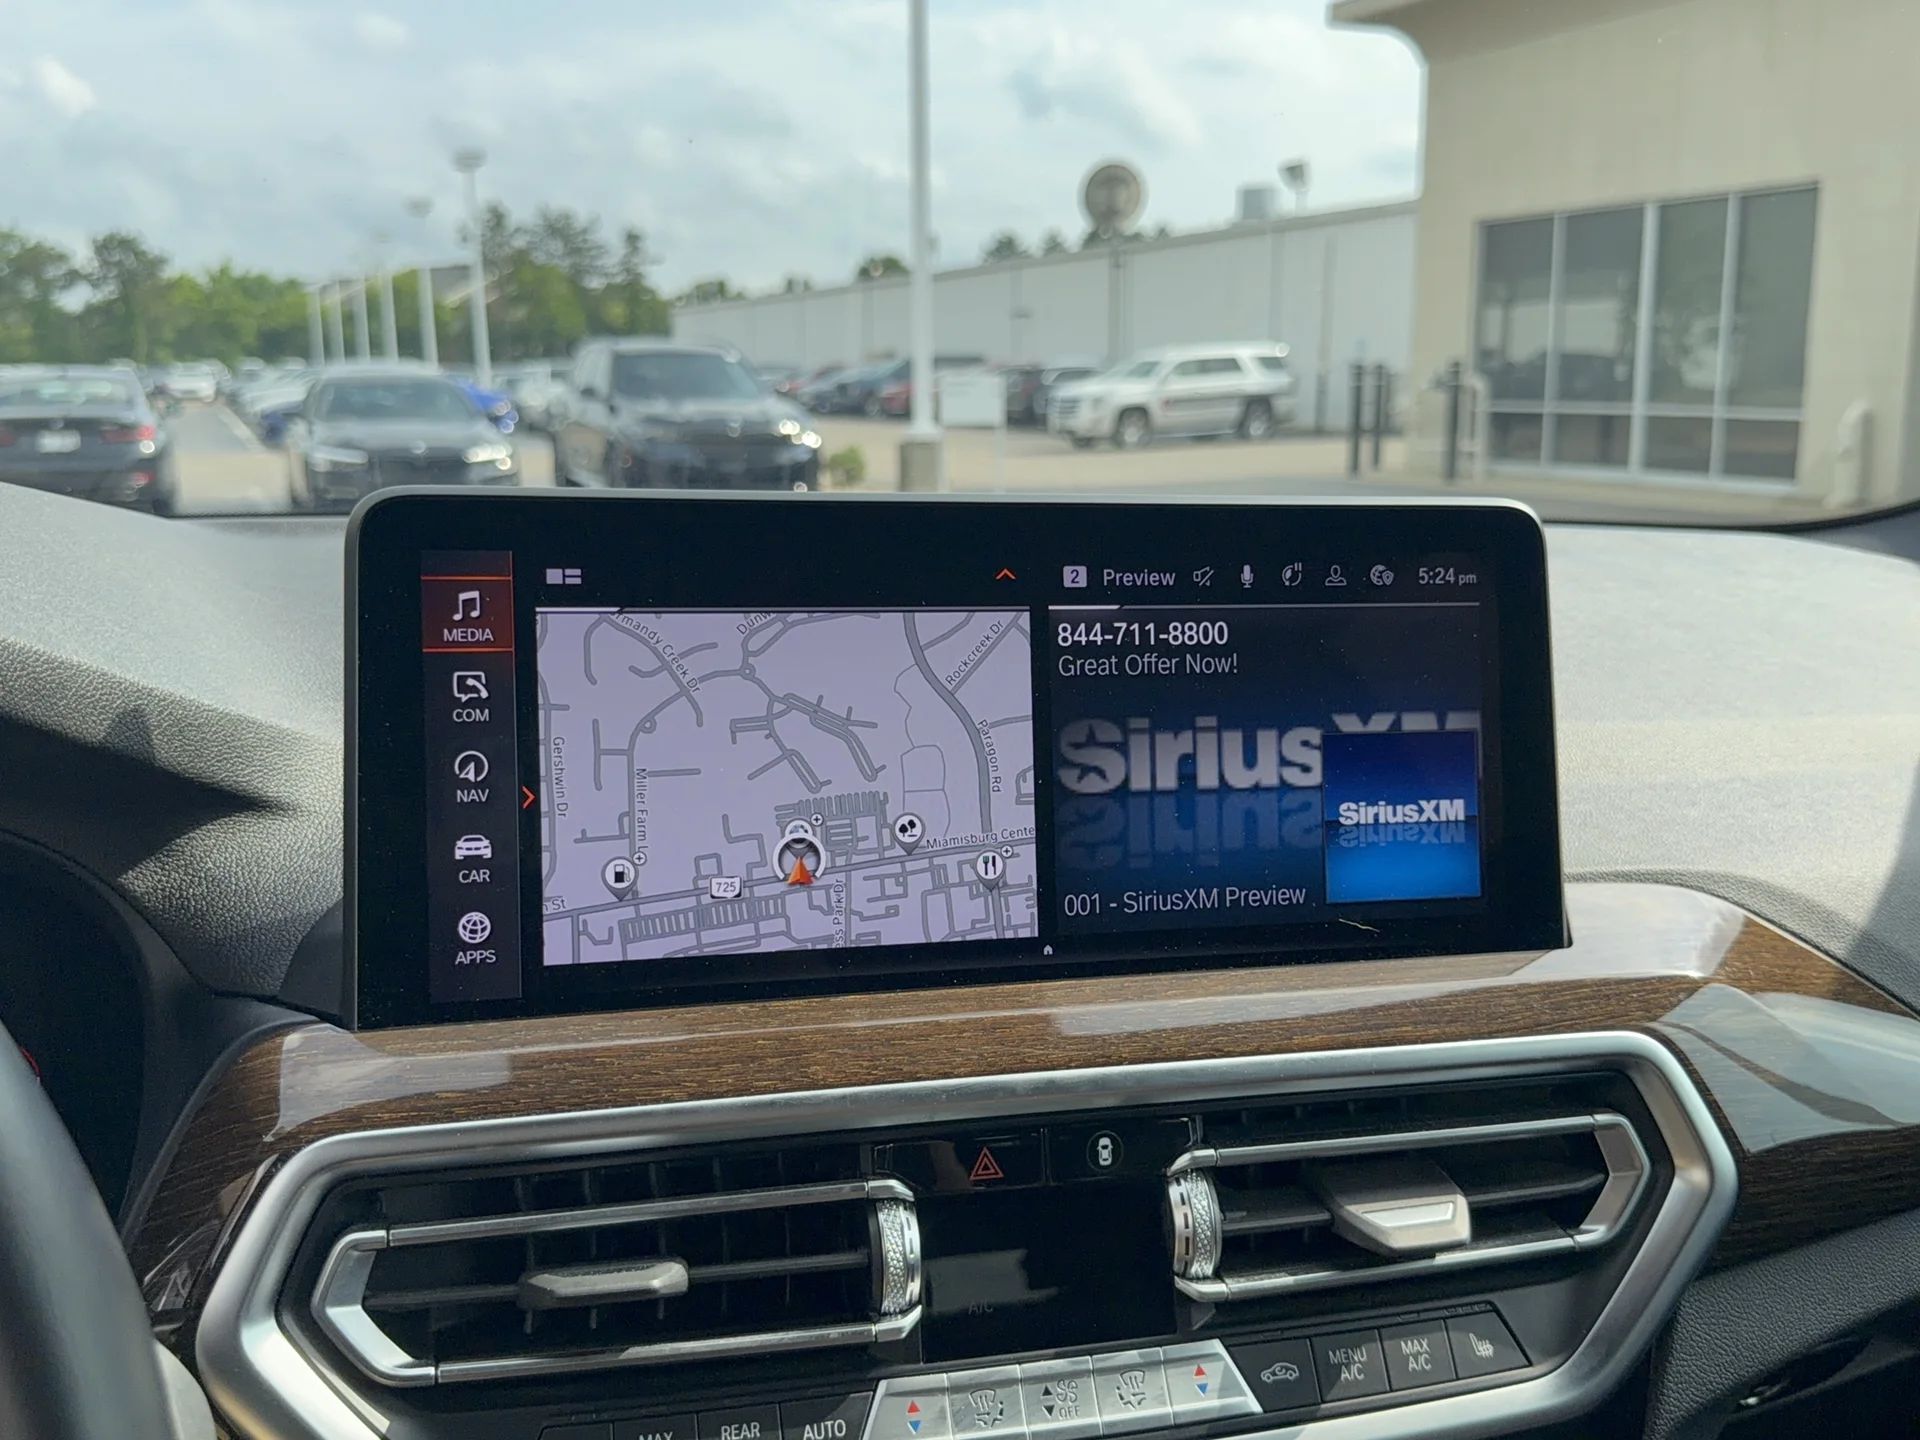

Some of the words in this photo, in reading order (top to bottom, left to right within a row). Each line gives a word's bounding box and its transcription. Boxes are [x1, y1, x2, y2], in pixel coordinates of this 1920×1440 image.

[1069, 569, 1081, 585] 2
[1103, 568, 1176, 587] Preview
[1418, 567, 1455, 585] 5:24
[1458, 572, 1477, 586] pm
[443, 628, 494, 643] MEDIA
[1057, 621, 1229, 647] 844-711-8800
[945, 633, 994, 686] Rockcreek
[989, 620, 1006, 635] Dr
[662, 644, 690, 679] Creek
[686, 677, 701, 693] Dr
[1058, 654, 1118, 677] Great
[1122, 653, 1180, 676] Offer
[1185, 652, 1238, 675] Now!
[452, 709, 489, 722] COM
[977, 719, 999, 773] Paragon
[991, 776, 1002, 793] Rd
[552, 736, 567, 799] Gershwin
[456, 788, 489, 803] NAV
[635, 768, 648, 805] Miller
[556, 802, 569, 818] Dr
[1338, 799, 1465, 826] SiriusXM
[637, 809, 649, 842] Farm
[926, 832, 998, 849] Miamisburg
[459, 869, 490, 883] CAR
[833, 878, 844, 893] Dr
[715, 881, 737, 893] 725
[551, 898, 567, 911] St
[1064, 892, 1101, 916] 001
[1123, 887, 1219, 914] SiriusXM
[1225, 884, 1306, 908] Preview
[833, 896, 844, 925] Park
[455, 950, 497, 965] APPS
[1328, 1345, 1368, 1365] MENU
[1400, 1337, 1431, 1356] MAX
[1340, 1363, 1365, 1381] A/C
[1408, 1353, 1432, 1372] A/C
[1059, 1405, 1080, 1419] OFF
[721, 1421, 761, 1440] REAR
[803, 1419, 847, 1440] AUTO
